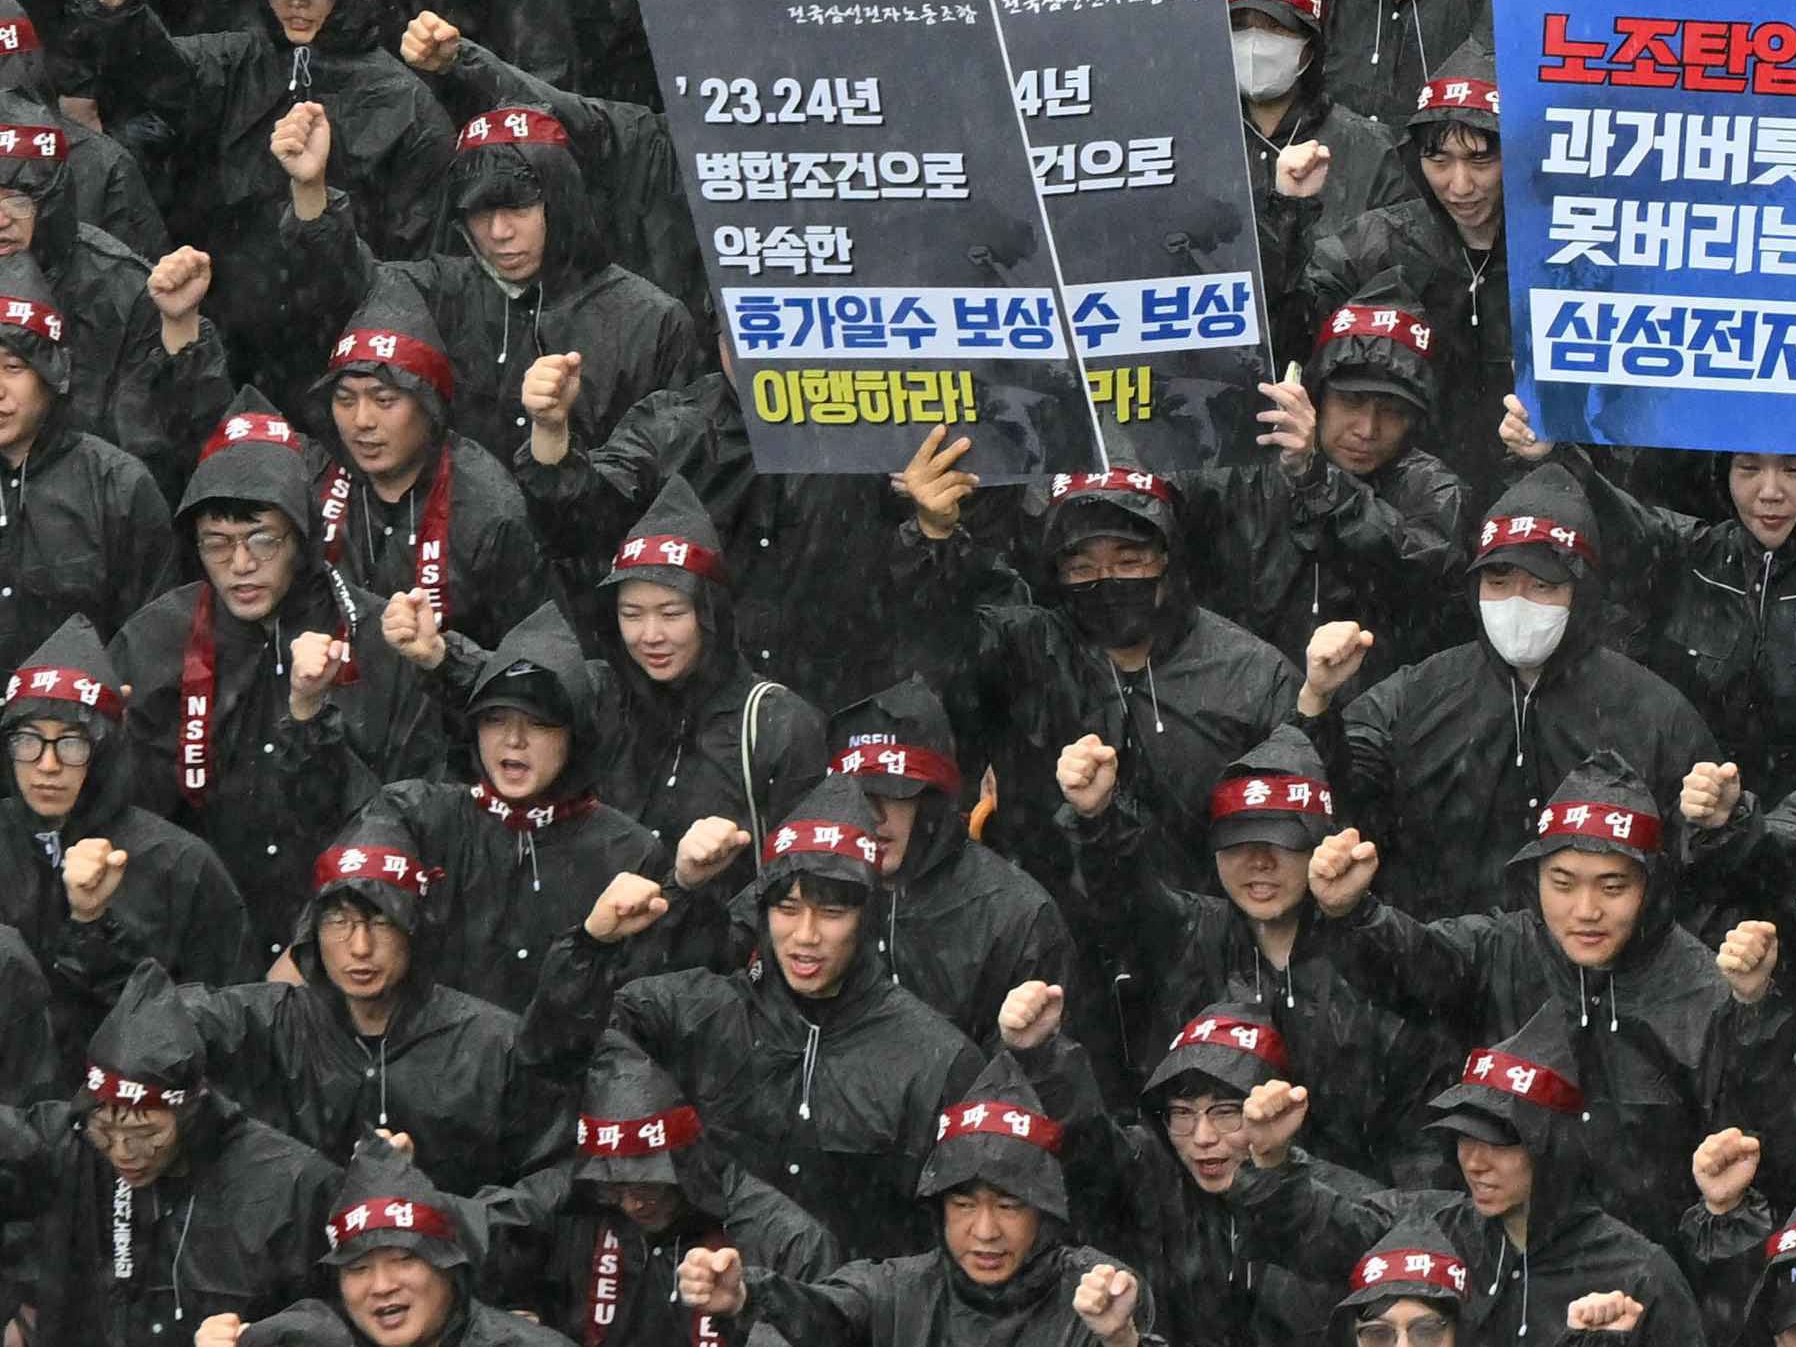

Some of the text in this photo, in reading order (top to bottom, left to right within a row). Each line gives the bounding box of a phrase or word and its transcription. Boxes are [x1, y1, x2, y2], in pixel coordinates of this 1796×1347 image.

[696, 152, 970, 201] 병합조건으로
[714, 226, 853, 274] 약속한
[736, 296, 1054, 350] 휴가일수 보상
[752, 370, 978, 425] 이행하라!
